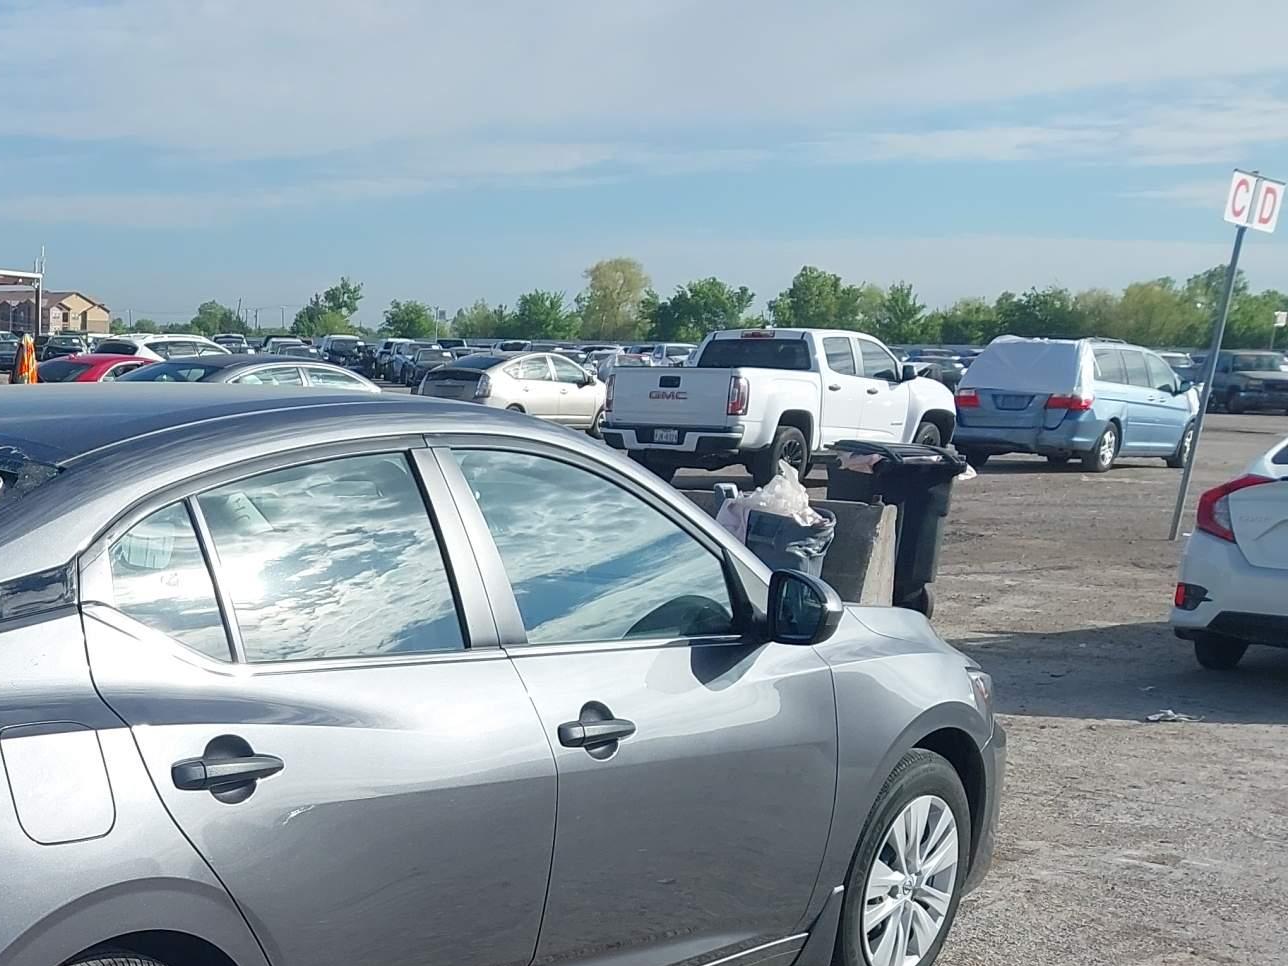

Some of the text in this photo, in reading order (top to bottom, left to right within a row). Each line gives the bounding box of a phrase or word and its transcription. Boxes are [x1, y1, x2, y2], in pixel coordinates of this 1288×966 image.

[1232, 178, 1250, 217] C
[1258, 187, 1277, 224] D
[649, 390, 688, 400] GMC
